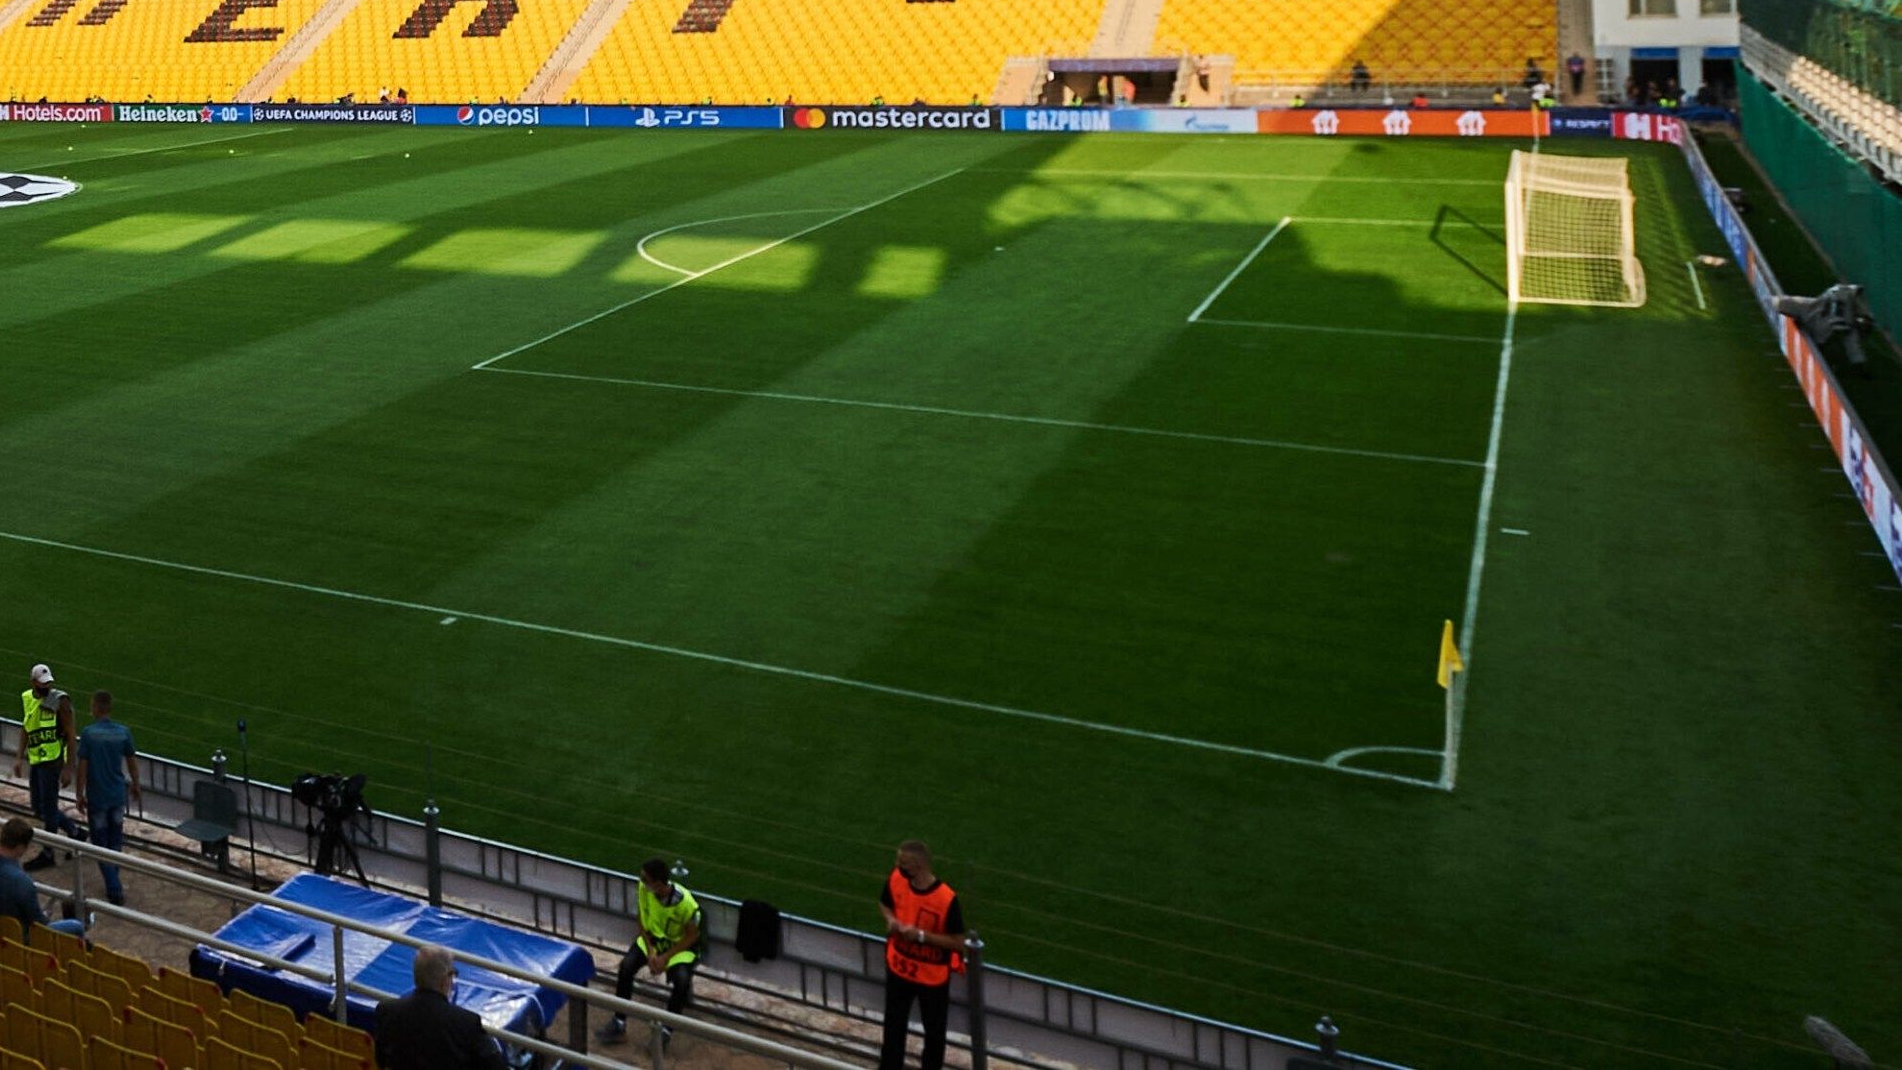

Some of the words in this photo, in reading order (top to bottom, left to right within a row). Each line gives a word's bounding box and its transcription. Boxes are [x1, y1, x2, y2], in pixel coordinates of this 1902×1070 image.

[13, 104, 102, 122] Hotels.com
[118, 105, 198, 123] Heineken
[265, 109, 293, 120] UEFA
[294, 109, 355, 121] CHAMPIONS
[357, 109, 398, 122] LEAGUE
[478, 106, 539, 126] pepsi
[663, 110, 720, 126] PS5
[832, 108, 991, 128] mastercard
[1025, 109, 1111, 131] GAZPROM
